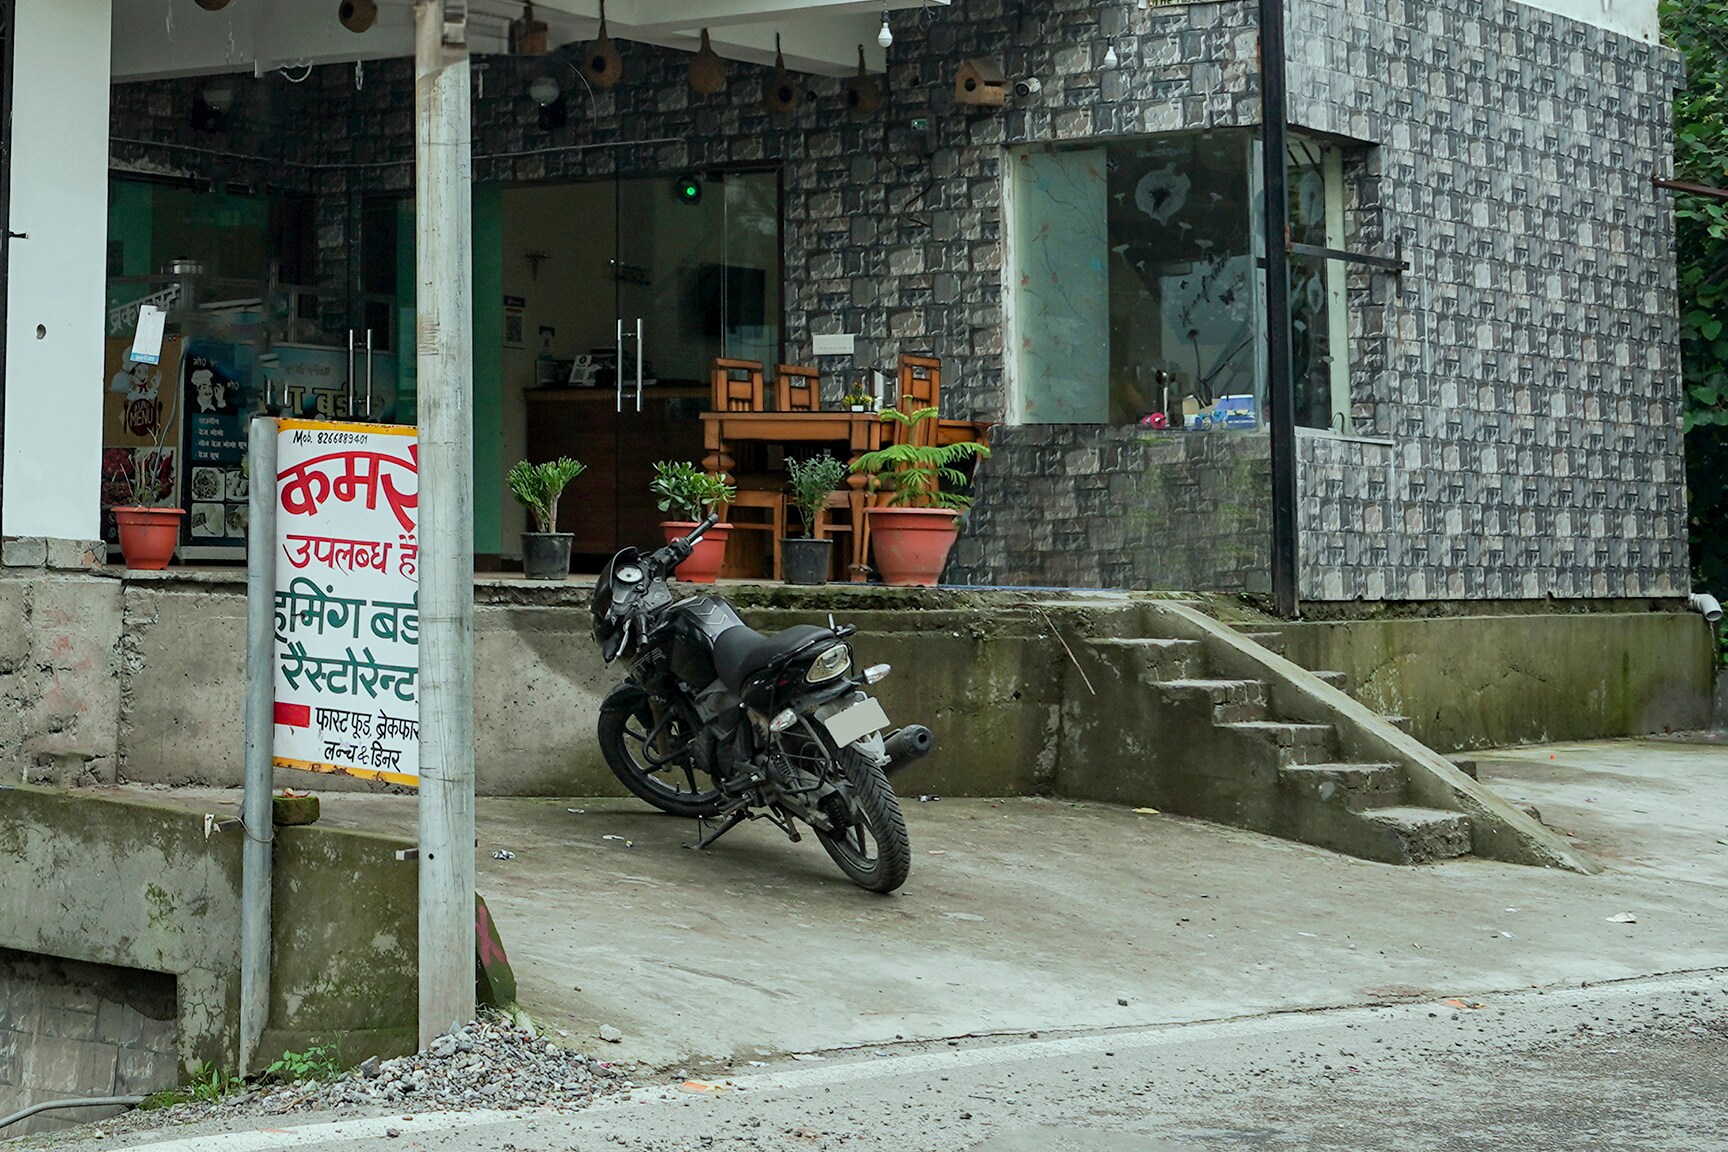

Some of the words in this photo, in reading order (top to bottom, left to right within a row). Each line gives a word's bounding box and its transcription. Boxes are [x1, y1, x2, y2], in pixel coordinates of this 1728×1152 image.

[129, 408, 153, 427] MENU
[293, 430, 313, 446] Mob.
[282, 534, 393, 576] उपलब्ध
[315, 707, 351, 733] फास्ट
[324, 740, 358, 763] लन्च
[370, 740, 402, 773] डिनर
